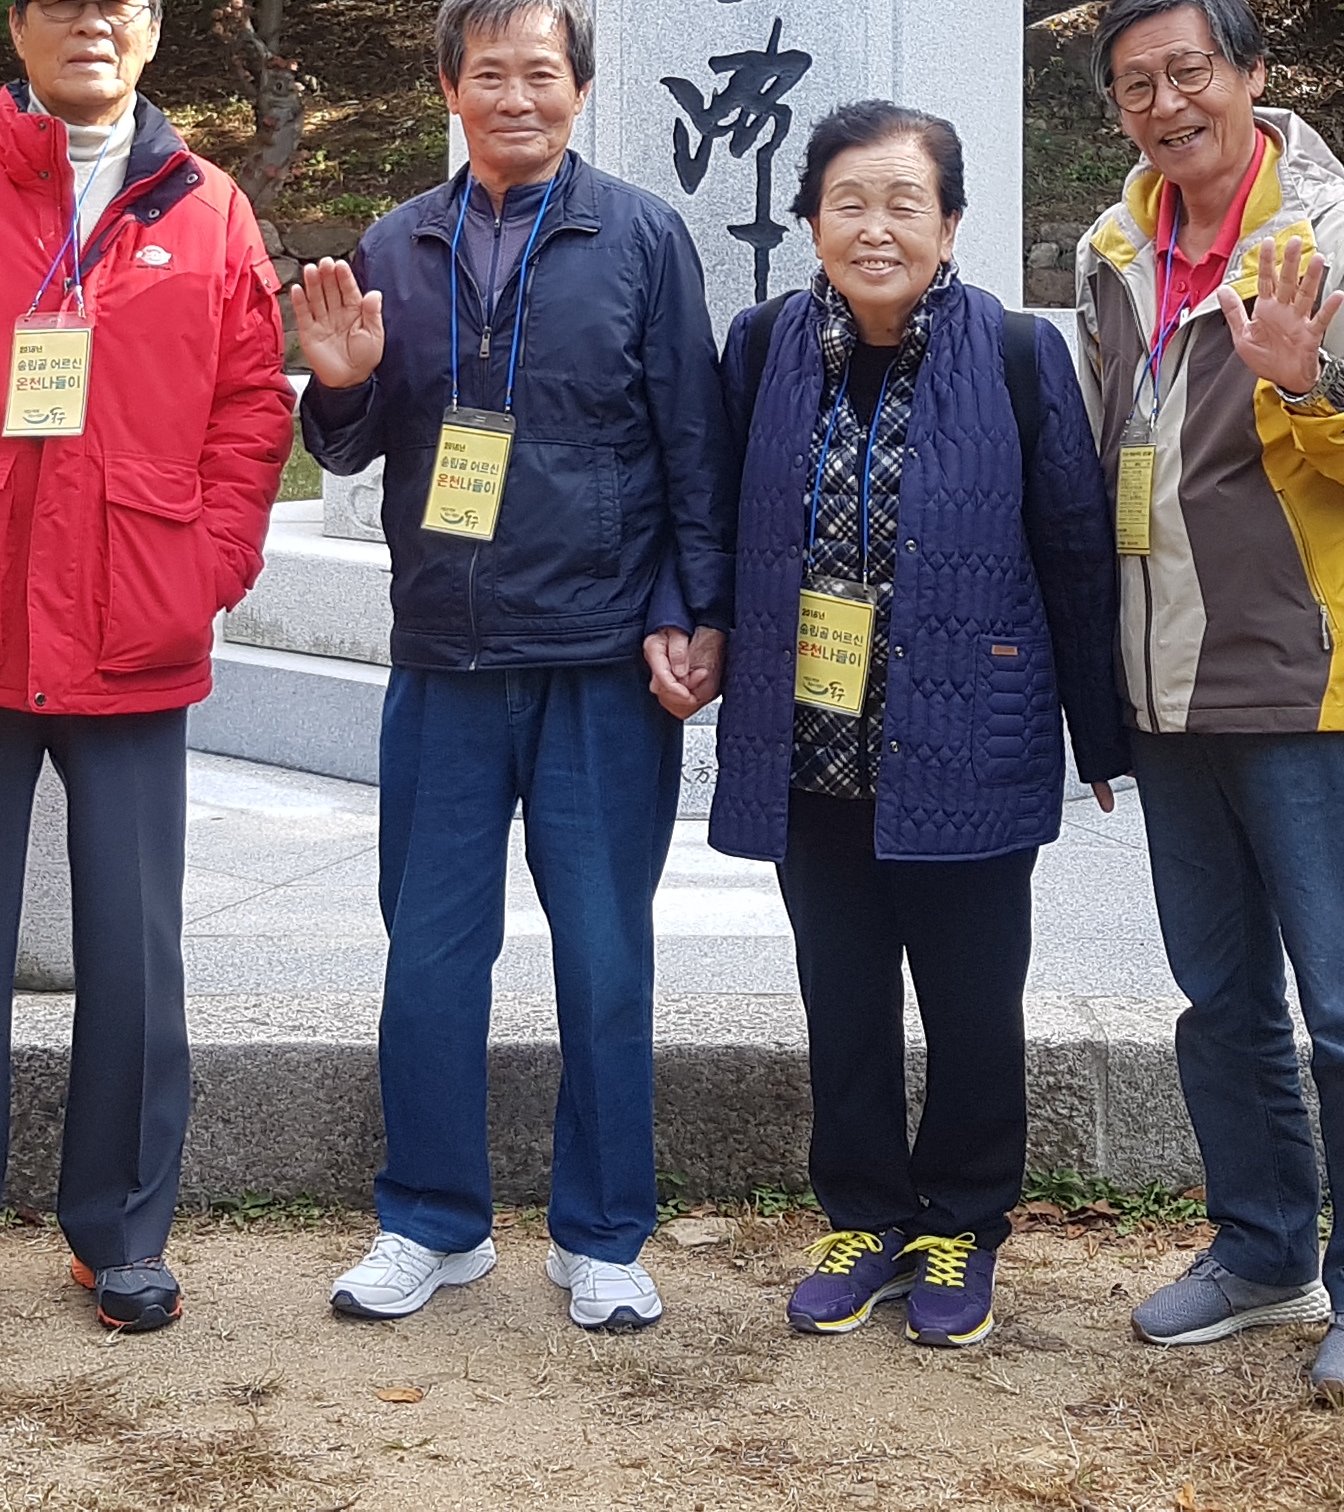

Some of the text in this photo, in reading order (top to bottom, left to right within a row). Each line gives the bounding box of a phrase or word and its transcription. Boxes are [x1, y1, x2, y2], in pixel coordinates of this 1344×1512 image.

[50, 358, 82, 370] 어르신
[16, 375, 81, 391] 온천나들이
[470, 460, 500, 476] 어르신
[437, 473, 496, 495] 온천나들이
[832, 630, 864, 648] 어르신
[798, 639, 862, 667] 온천나들이
